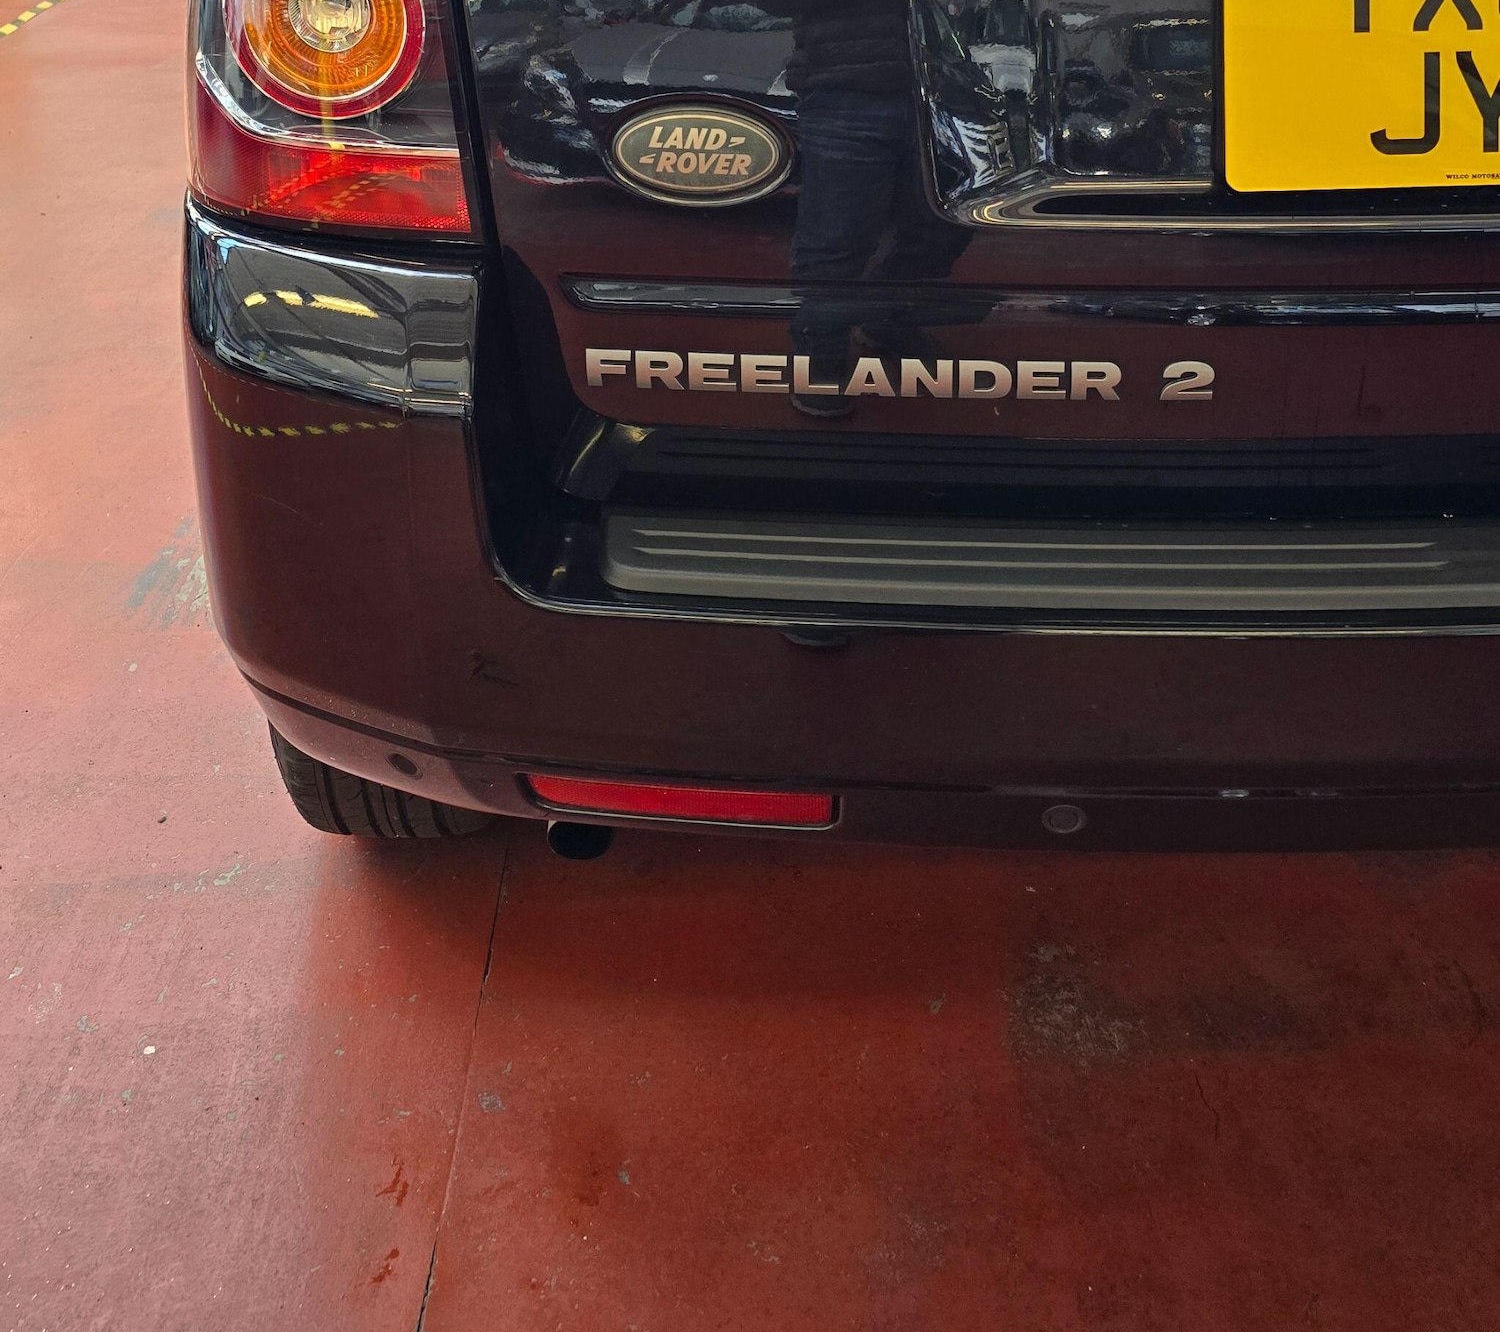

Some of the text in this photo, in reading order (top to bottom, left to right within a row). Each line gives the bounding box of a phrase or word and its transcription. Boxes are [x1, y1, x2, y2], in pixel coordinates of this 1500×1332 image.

[1370, 50, 1500, 156] JY
[648, 125, 728, 151] LAND
[655, 151, 753, 176] ROVER
[1471, 172, 1500, 180] MOTOSA
[584, 347, 1217, 401] FREELANDER 2
